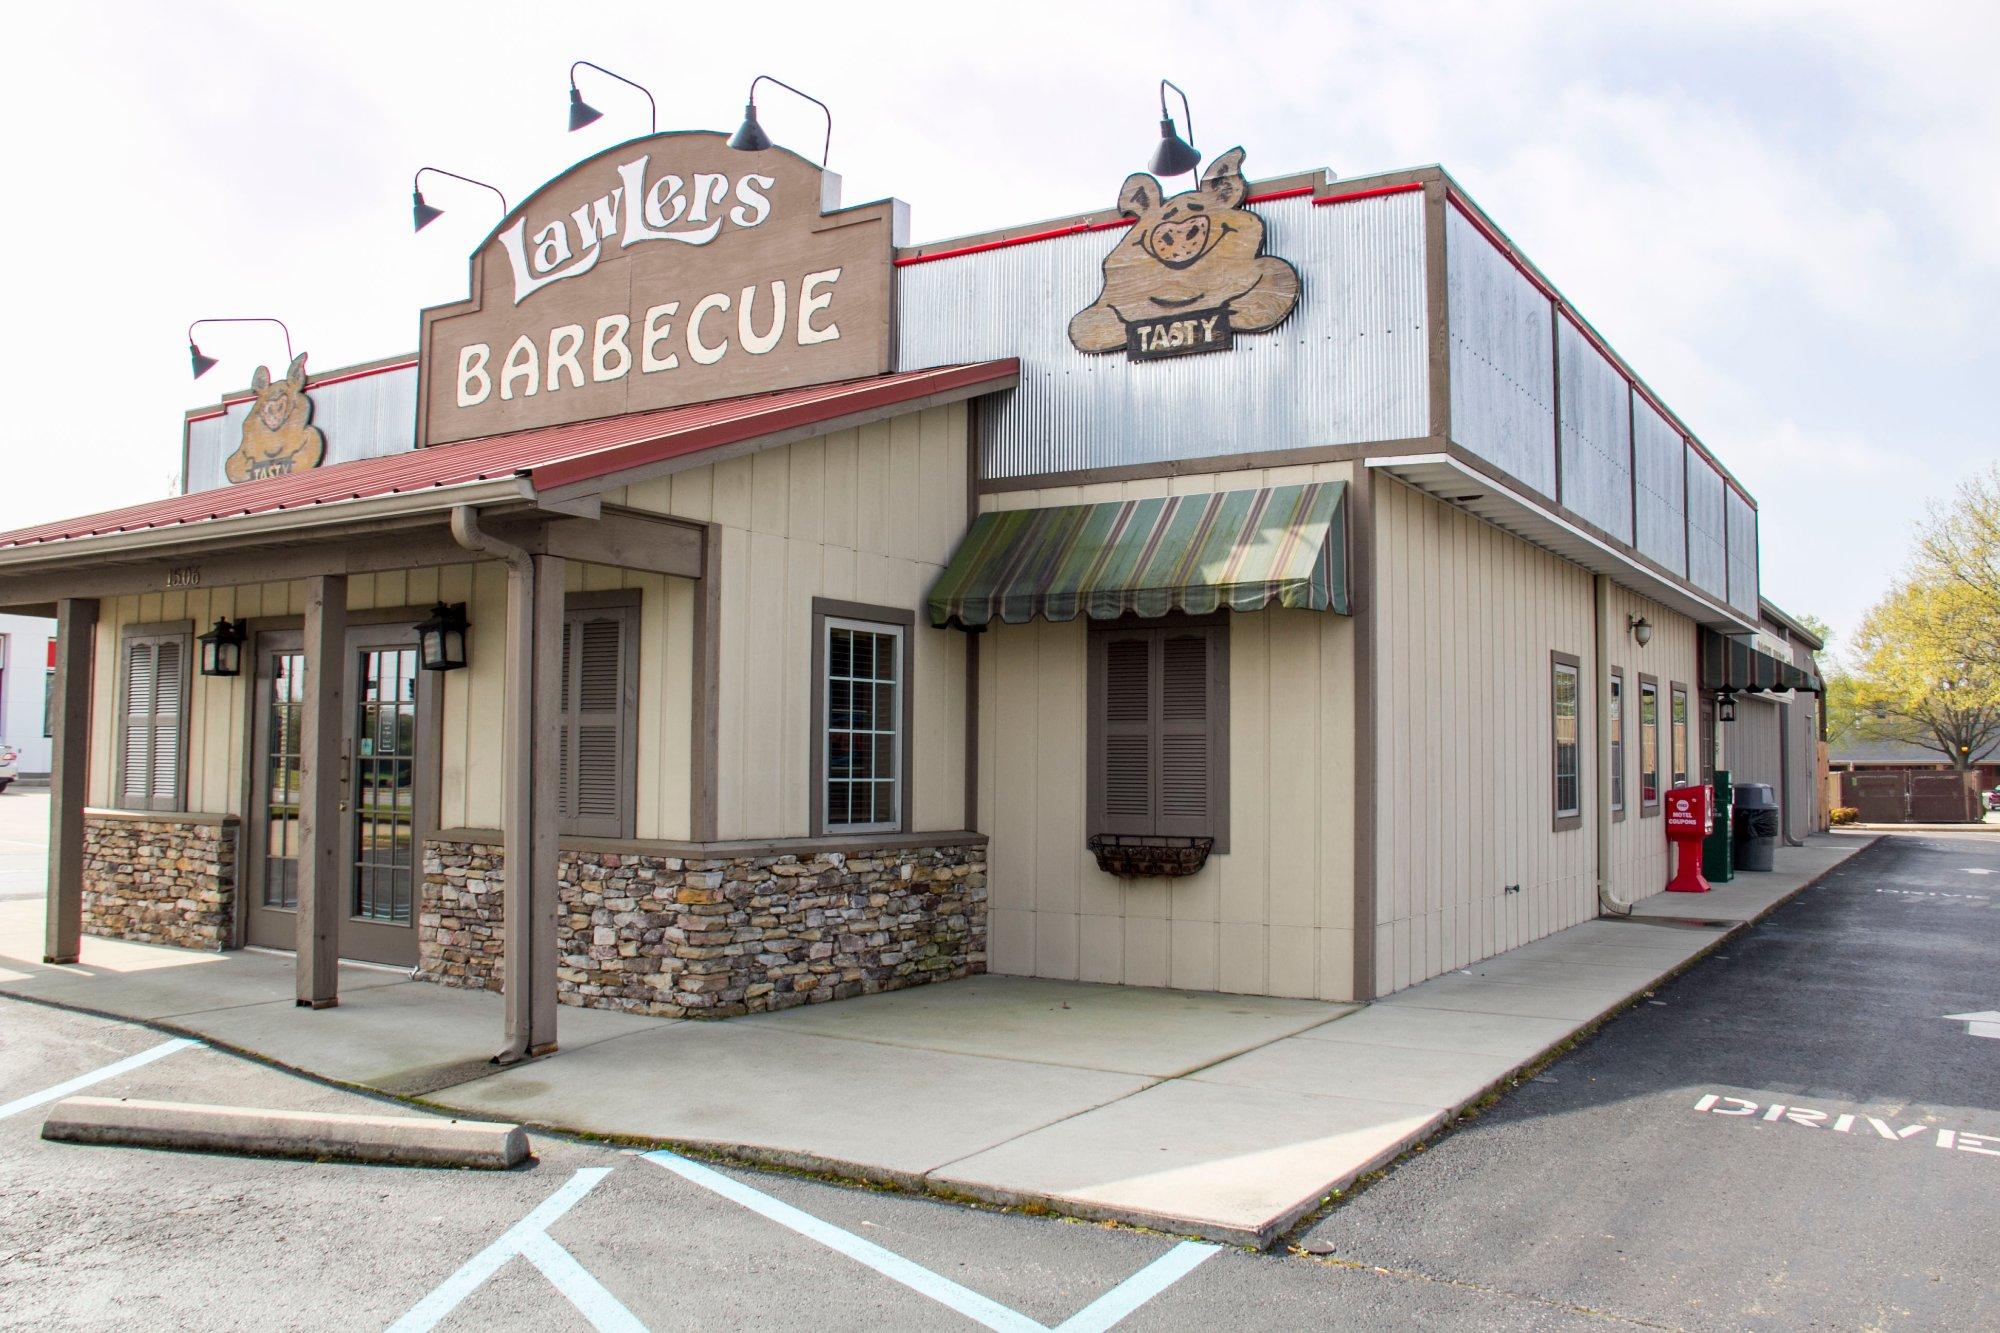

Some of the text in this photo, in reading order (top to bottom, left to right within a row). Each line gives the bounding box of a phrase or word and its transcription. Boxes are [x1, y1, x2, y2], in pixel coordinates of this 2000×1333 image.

[456, 267, 843, 409] BARBECUE
[1136, 315, 1220, 352] TASTY
[254, 463, 290, 480] TASTY
[1694, 1094, 2000, 1156] DRIVE
